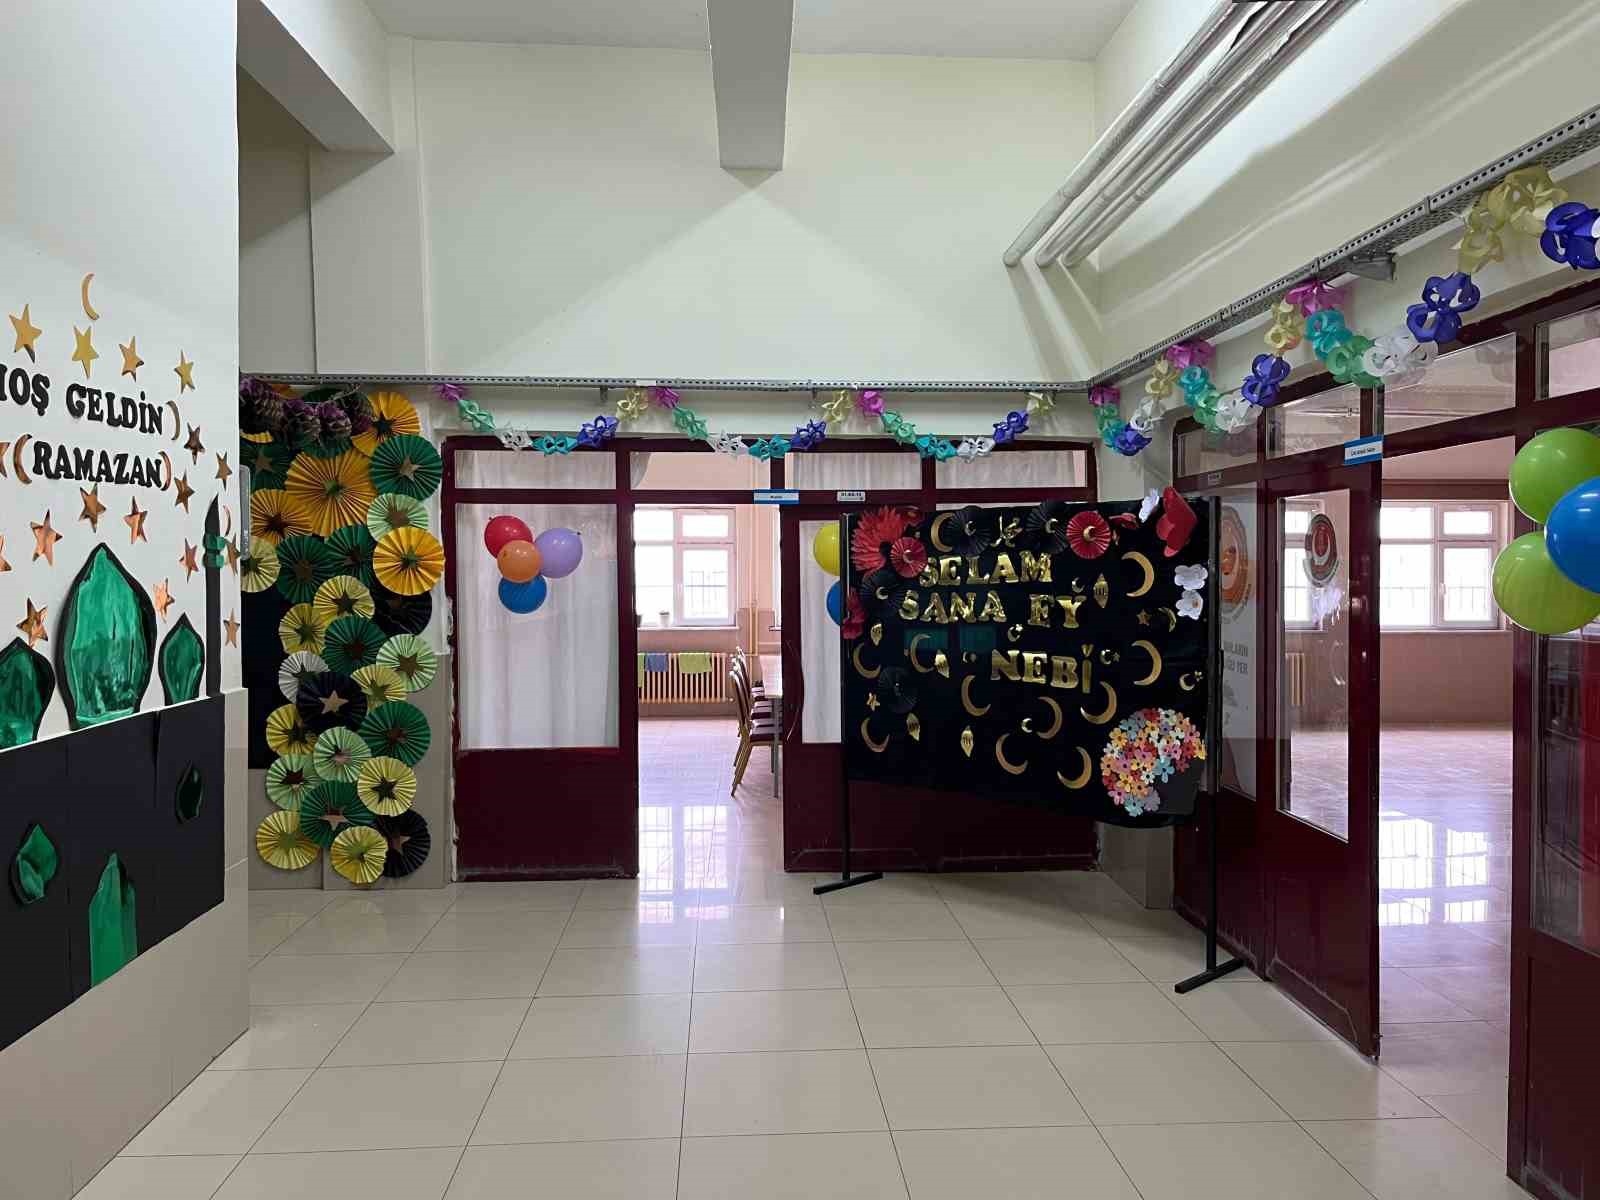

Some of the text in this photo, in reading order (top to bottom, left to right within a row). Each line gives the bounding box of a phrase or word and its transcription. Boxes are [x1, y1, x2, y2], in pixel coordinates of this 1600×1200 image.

[66, 383, 164, 435] GELDİN
[33, 441, 163, 489] RAMAZAN
[919, 551, 1053, 587] SELAM
[899, 589, 1087, 629] SANA EY
[989, 643, 1095, 694] NEBİ
